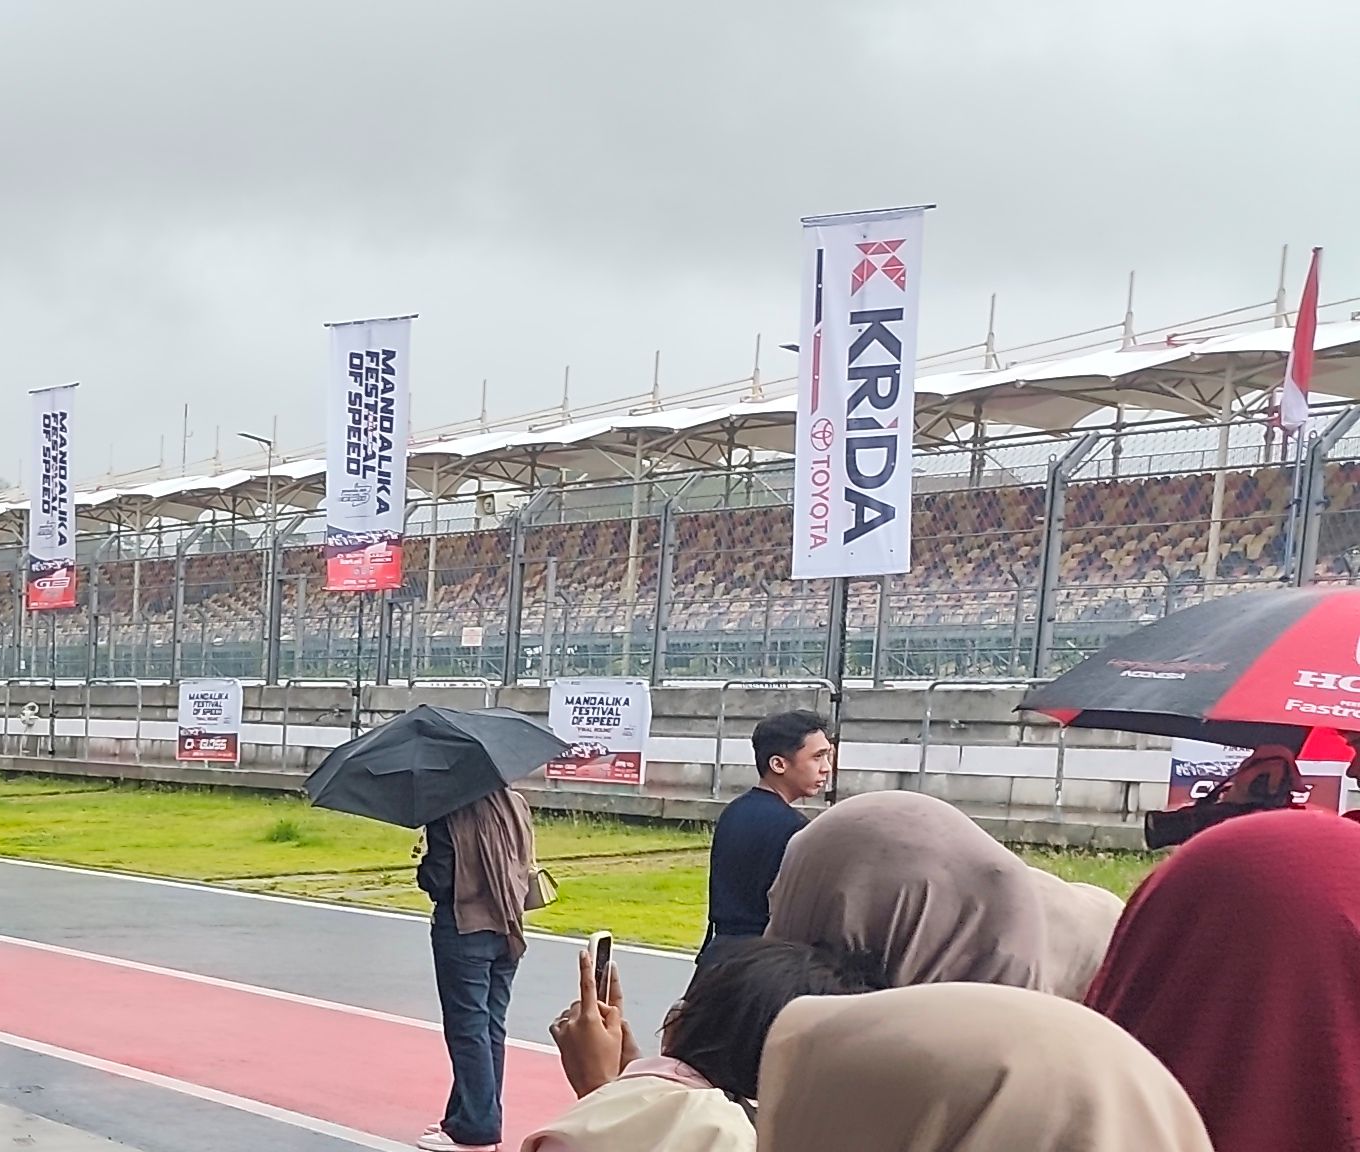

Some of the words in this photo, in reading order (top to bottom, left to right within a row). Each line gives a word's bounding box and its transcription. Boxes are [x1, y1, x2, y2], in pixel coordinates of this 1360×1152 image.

[347, 352, 364, 387] OF
[43, 414, 51, 441] OF
[346, 393, 363, 476] SPEED
[363, 349, 380, 480] FESTIVAL
[376, 349, 397, 516] MANDALIKA
[843, 307, 905, 545] KRIDA
[42, 446, 51, 514] SPEED
[51, 412, 59, 517] FESTIVAL
[57, 412, 68, 546] MANDALIKA
[809, 454, 831, 550] TOYOTA
[565, 696, 630, 706] MANDALIKA
[572, 706, 622, 716] FESTIVAL
[572, 716, 584, 726] OF
[586, 716, 621, 726] SPEED
